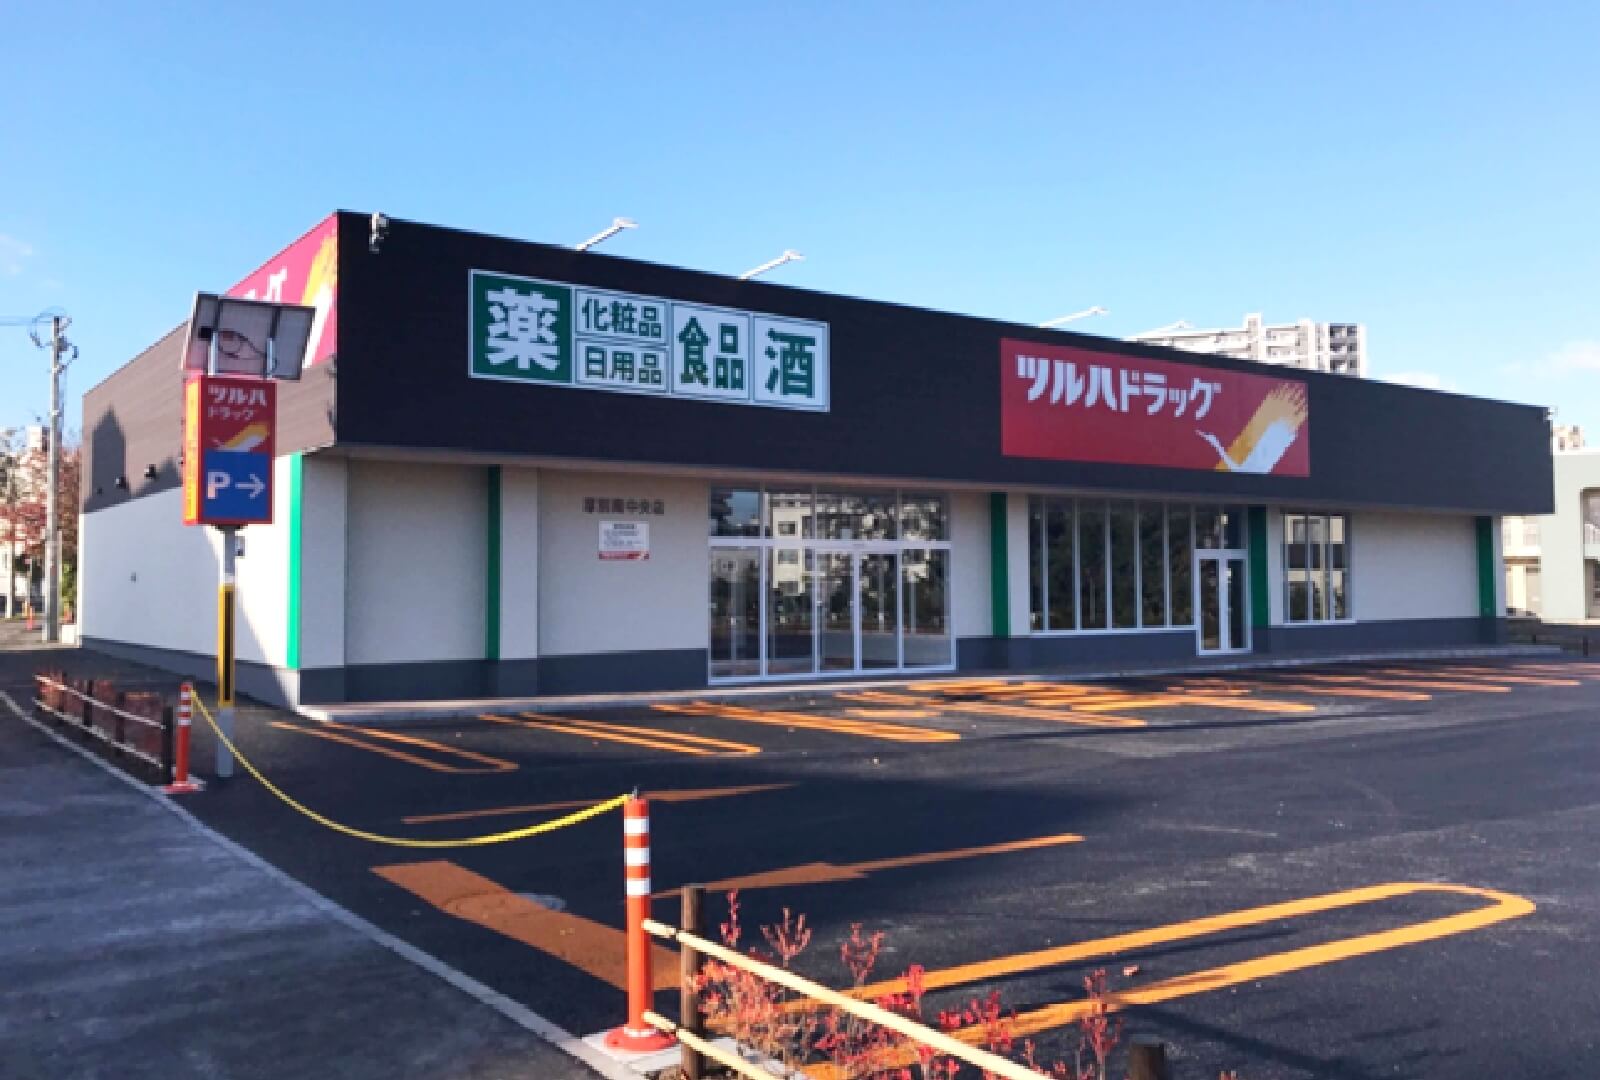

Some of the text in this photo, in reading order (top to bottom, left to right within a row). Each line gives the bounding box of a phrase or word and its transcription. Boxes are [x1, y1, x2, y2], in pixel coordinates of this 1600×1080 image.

[485, 286, 561, 371] 薬
[580, 297, 662, 338] 化粧品
[584, 345, 662, 385] 日用品
[677, 315, 745, 391] 食品
[764, 327, 816, 399] 酒
[207, 384, 267, 407] ツルハ
[1015, 354, 1223, 421] ツルハドラッグ
[206, 471, 230, 500] P
